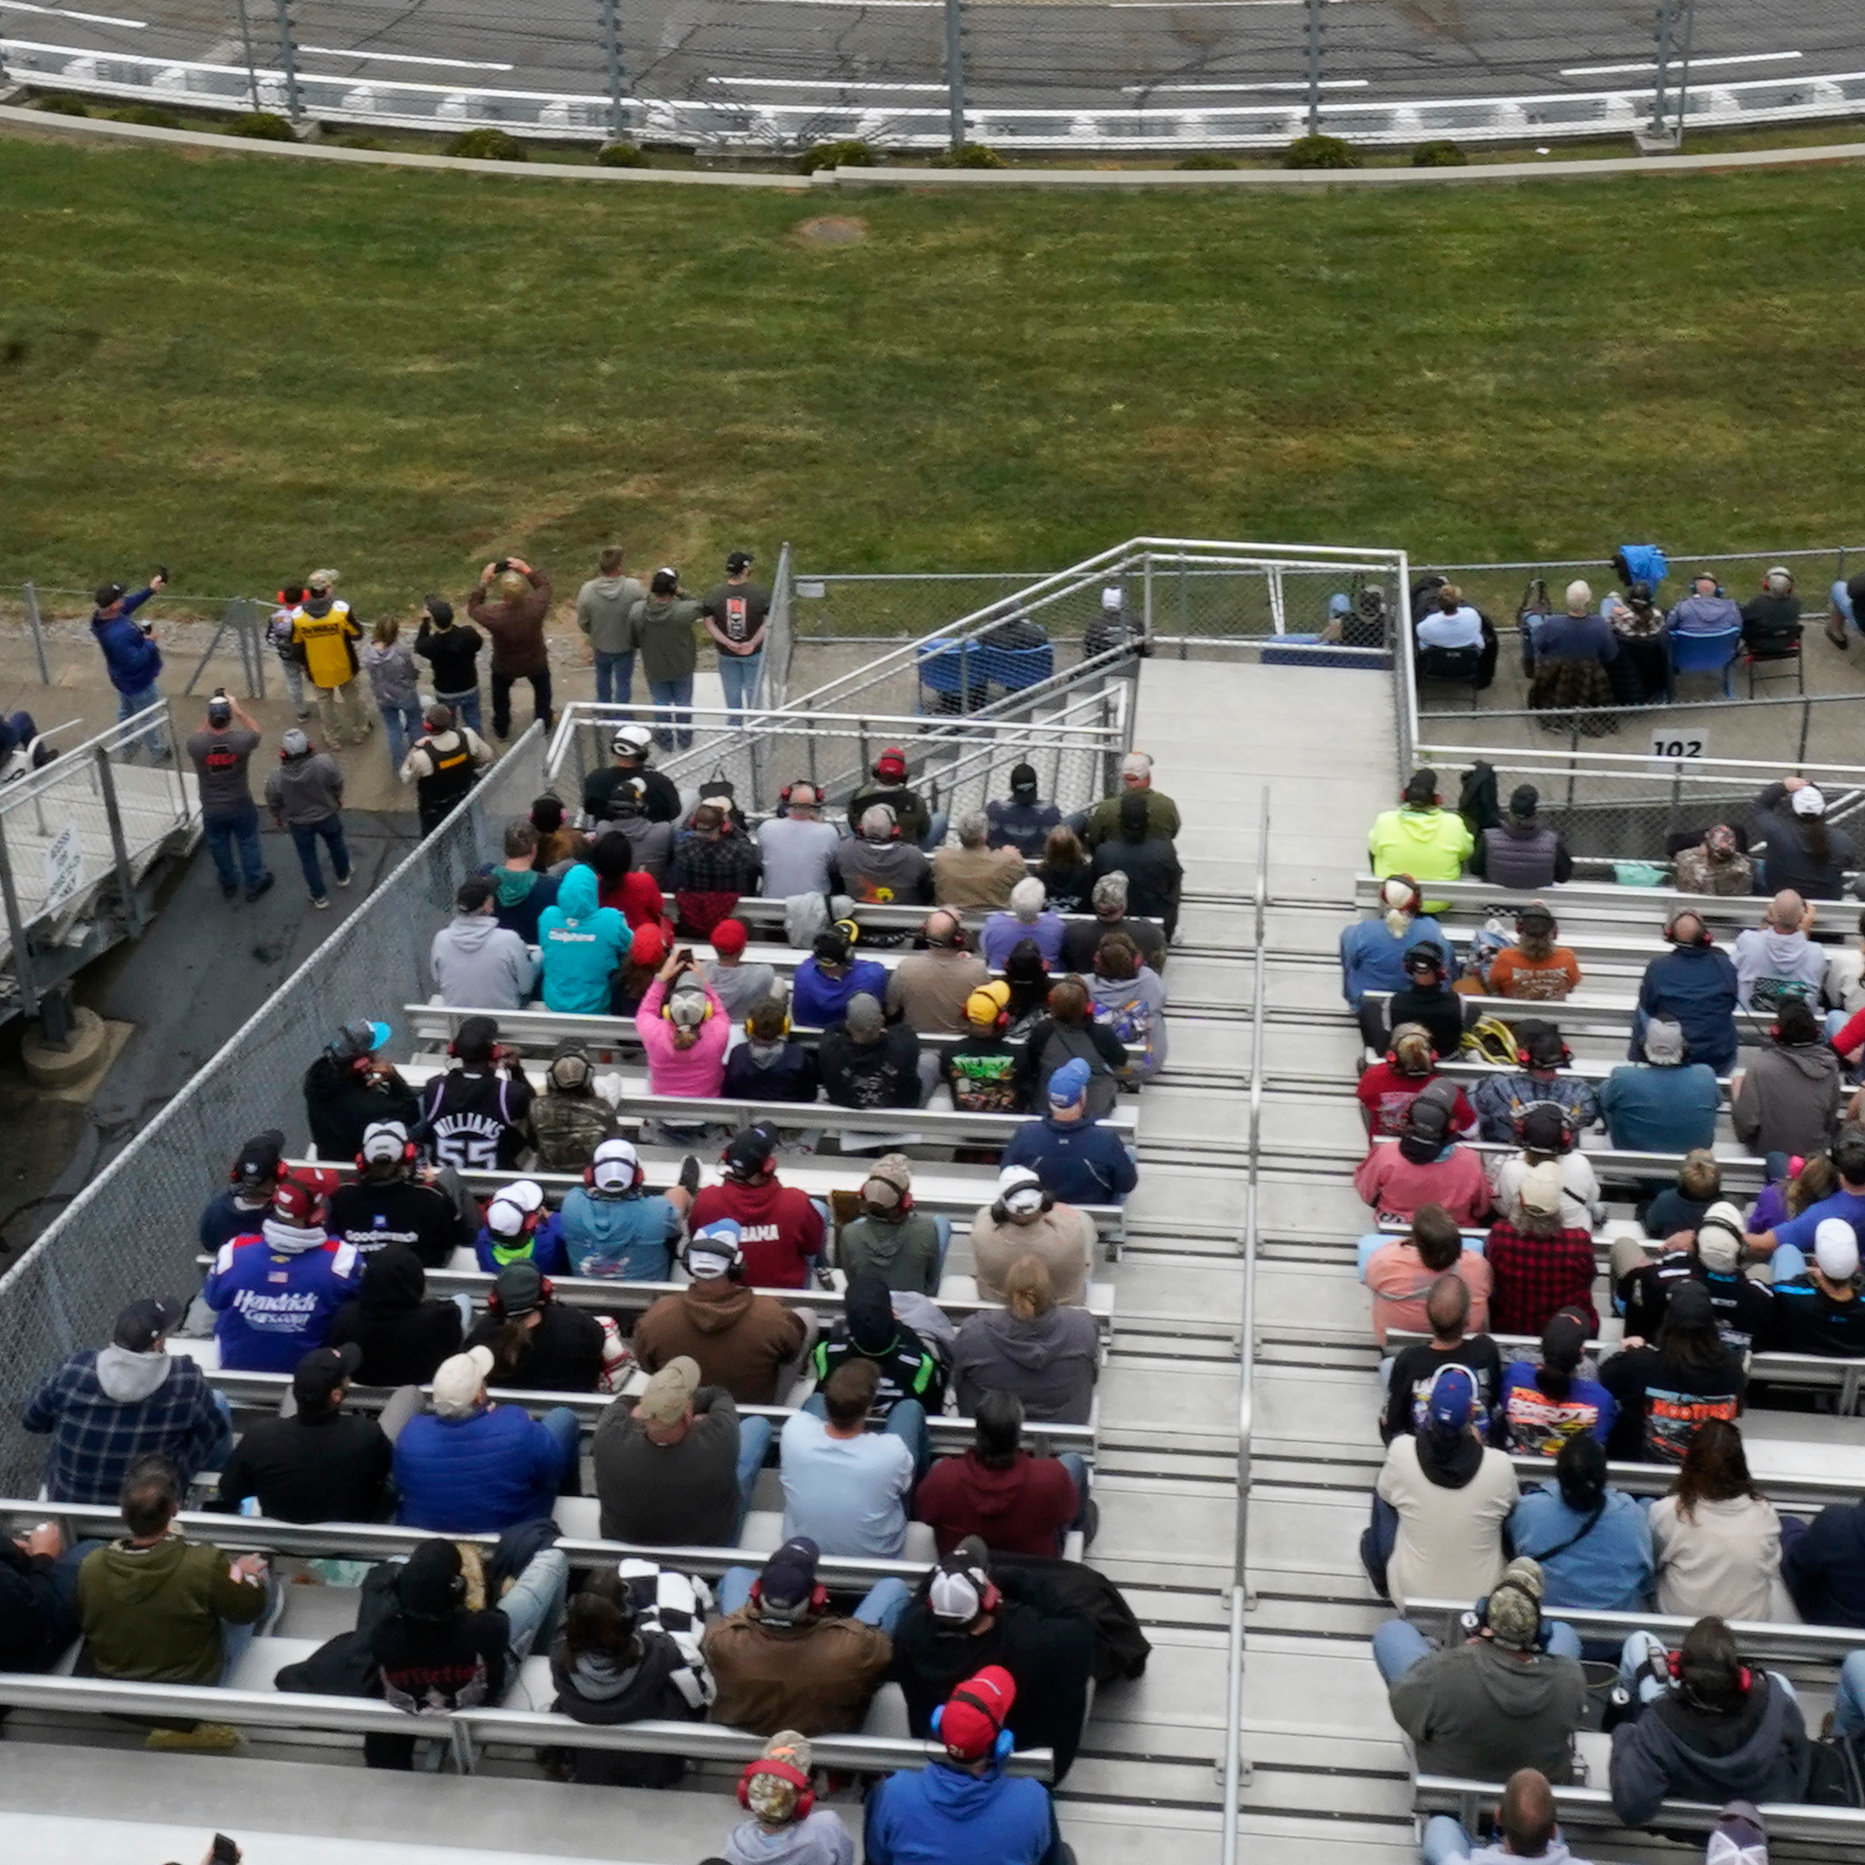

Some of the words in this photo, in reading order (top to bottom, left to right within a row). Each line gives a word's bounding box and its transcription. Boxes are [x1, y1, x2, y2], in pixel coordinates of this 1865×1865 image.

[1653, 741, 1702, 757] 102
[433, 1113, 505, 1139] WILLIAMS
[437, 1139, 499, 1170] 55
[234, 1290, 318, 1312] Hendrick
